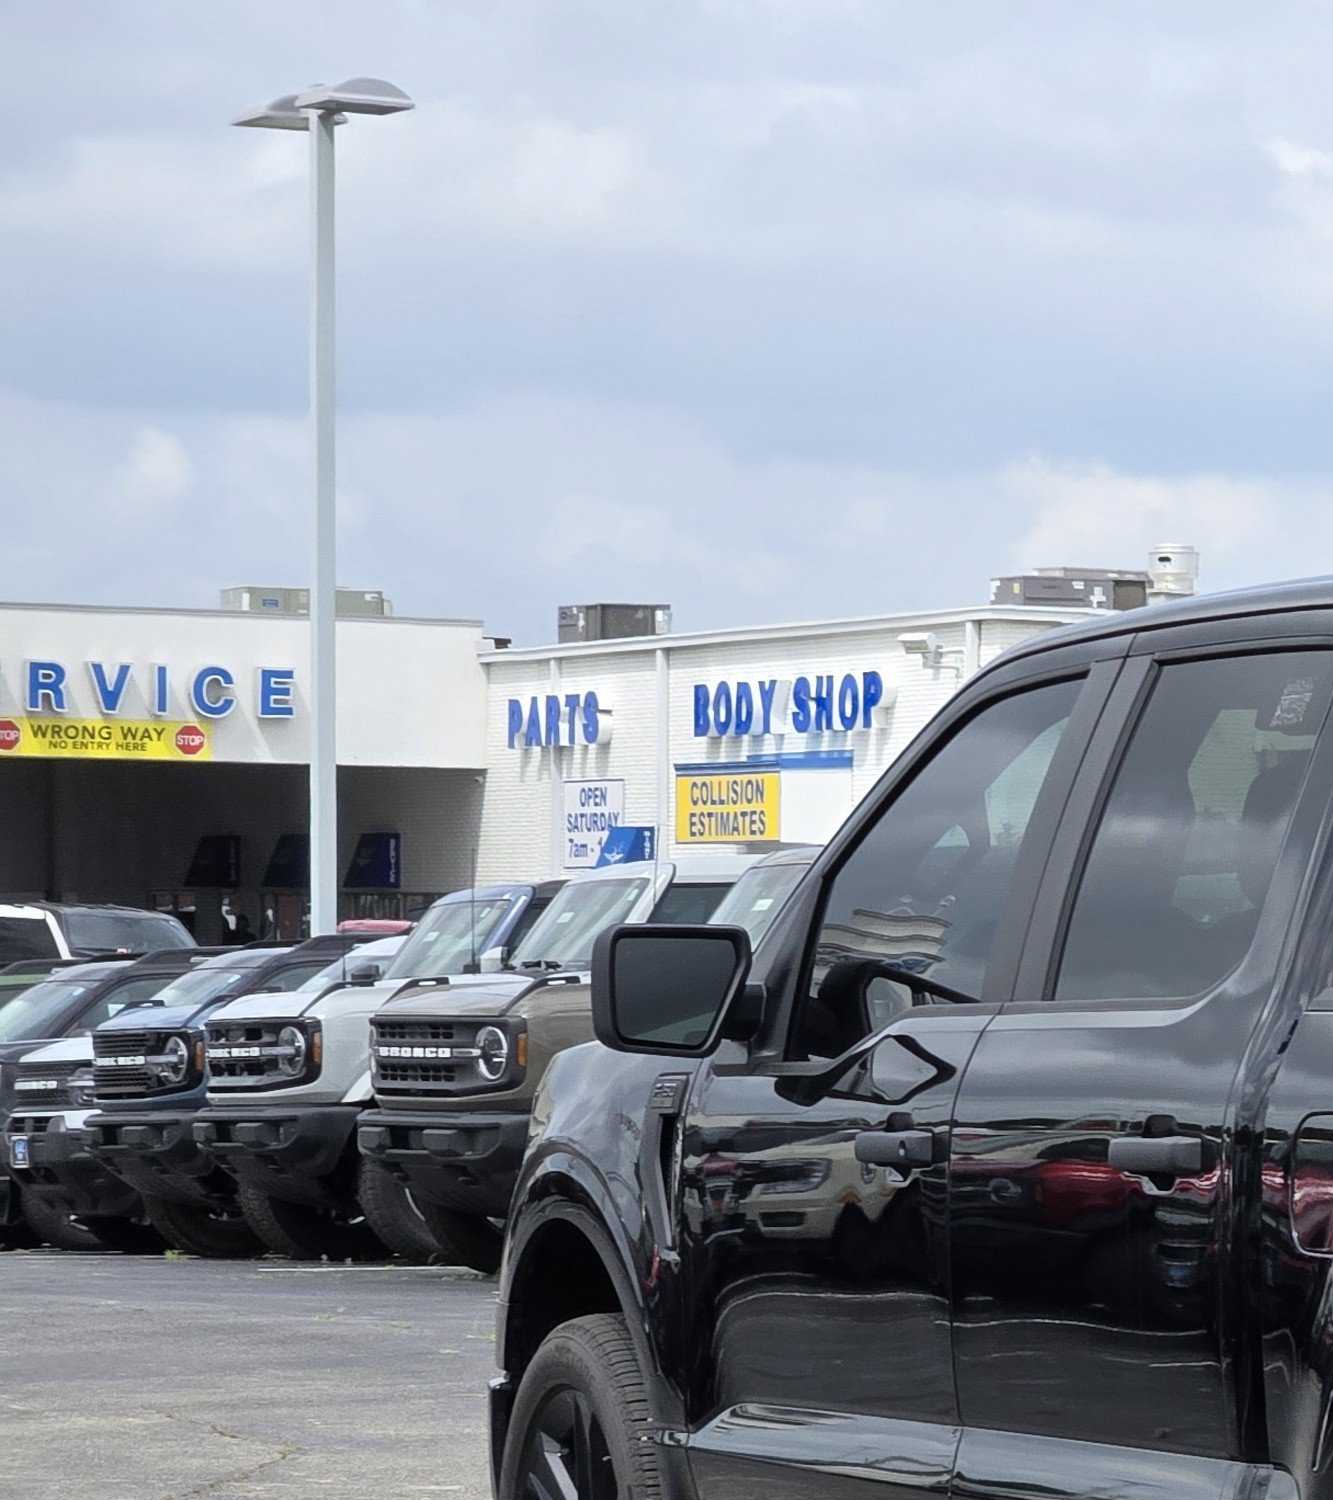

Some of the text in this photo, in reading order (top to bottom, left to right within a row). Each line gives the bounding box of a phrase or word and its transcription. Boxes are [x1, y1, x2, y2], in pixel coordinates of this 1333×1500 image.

[694, 671, 883, 737] BODY SHOP
[508, 691, 600, 749] PARTS
[30, 724, 166, 742] WRONG WAY
[177, 734, 203, 747] STOP
[48, 739, 147, 752] NO ENTRY HERE
[580, 787, 607, 807] OPEN
[690, 779, 765, 807] COLLISION
[567, 812, 620, 832] SATURDAY
[689, 810, 766, 838] ESTIMATES
[568, 838, 588, 858] 7am
